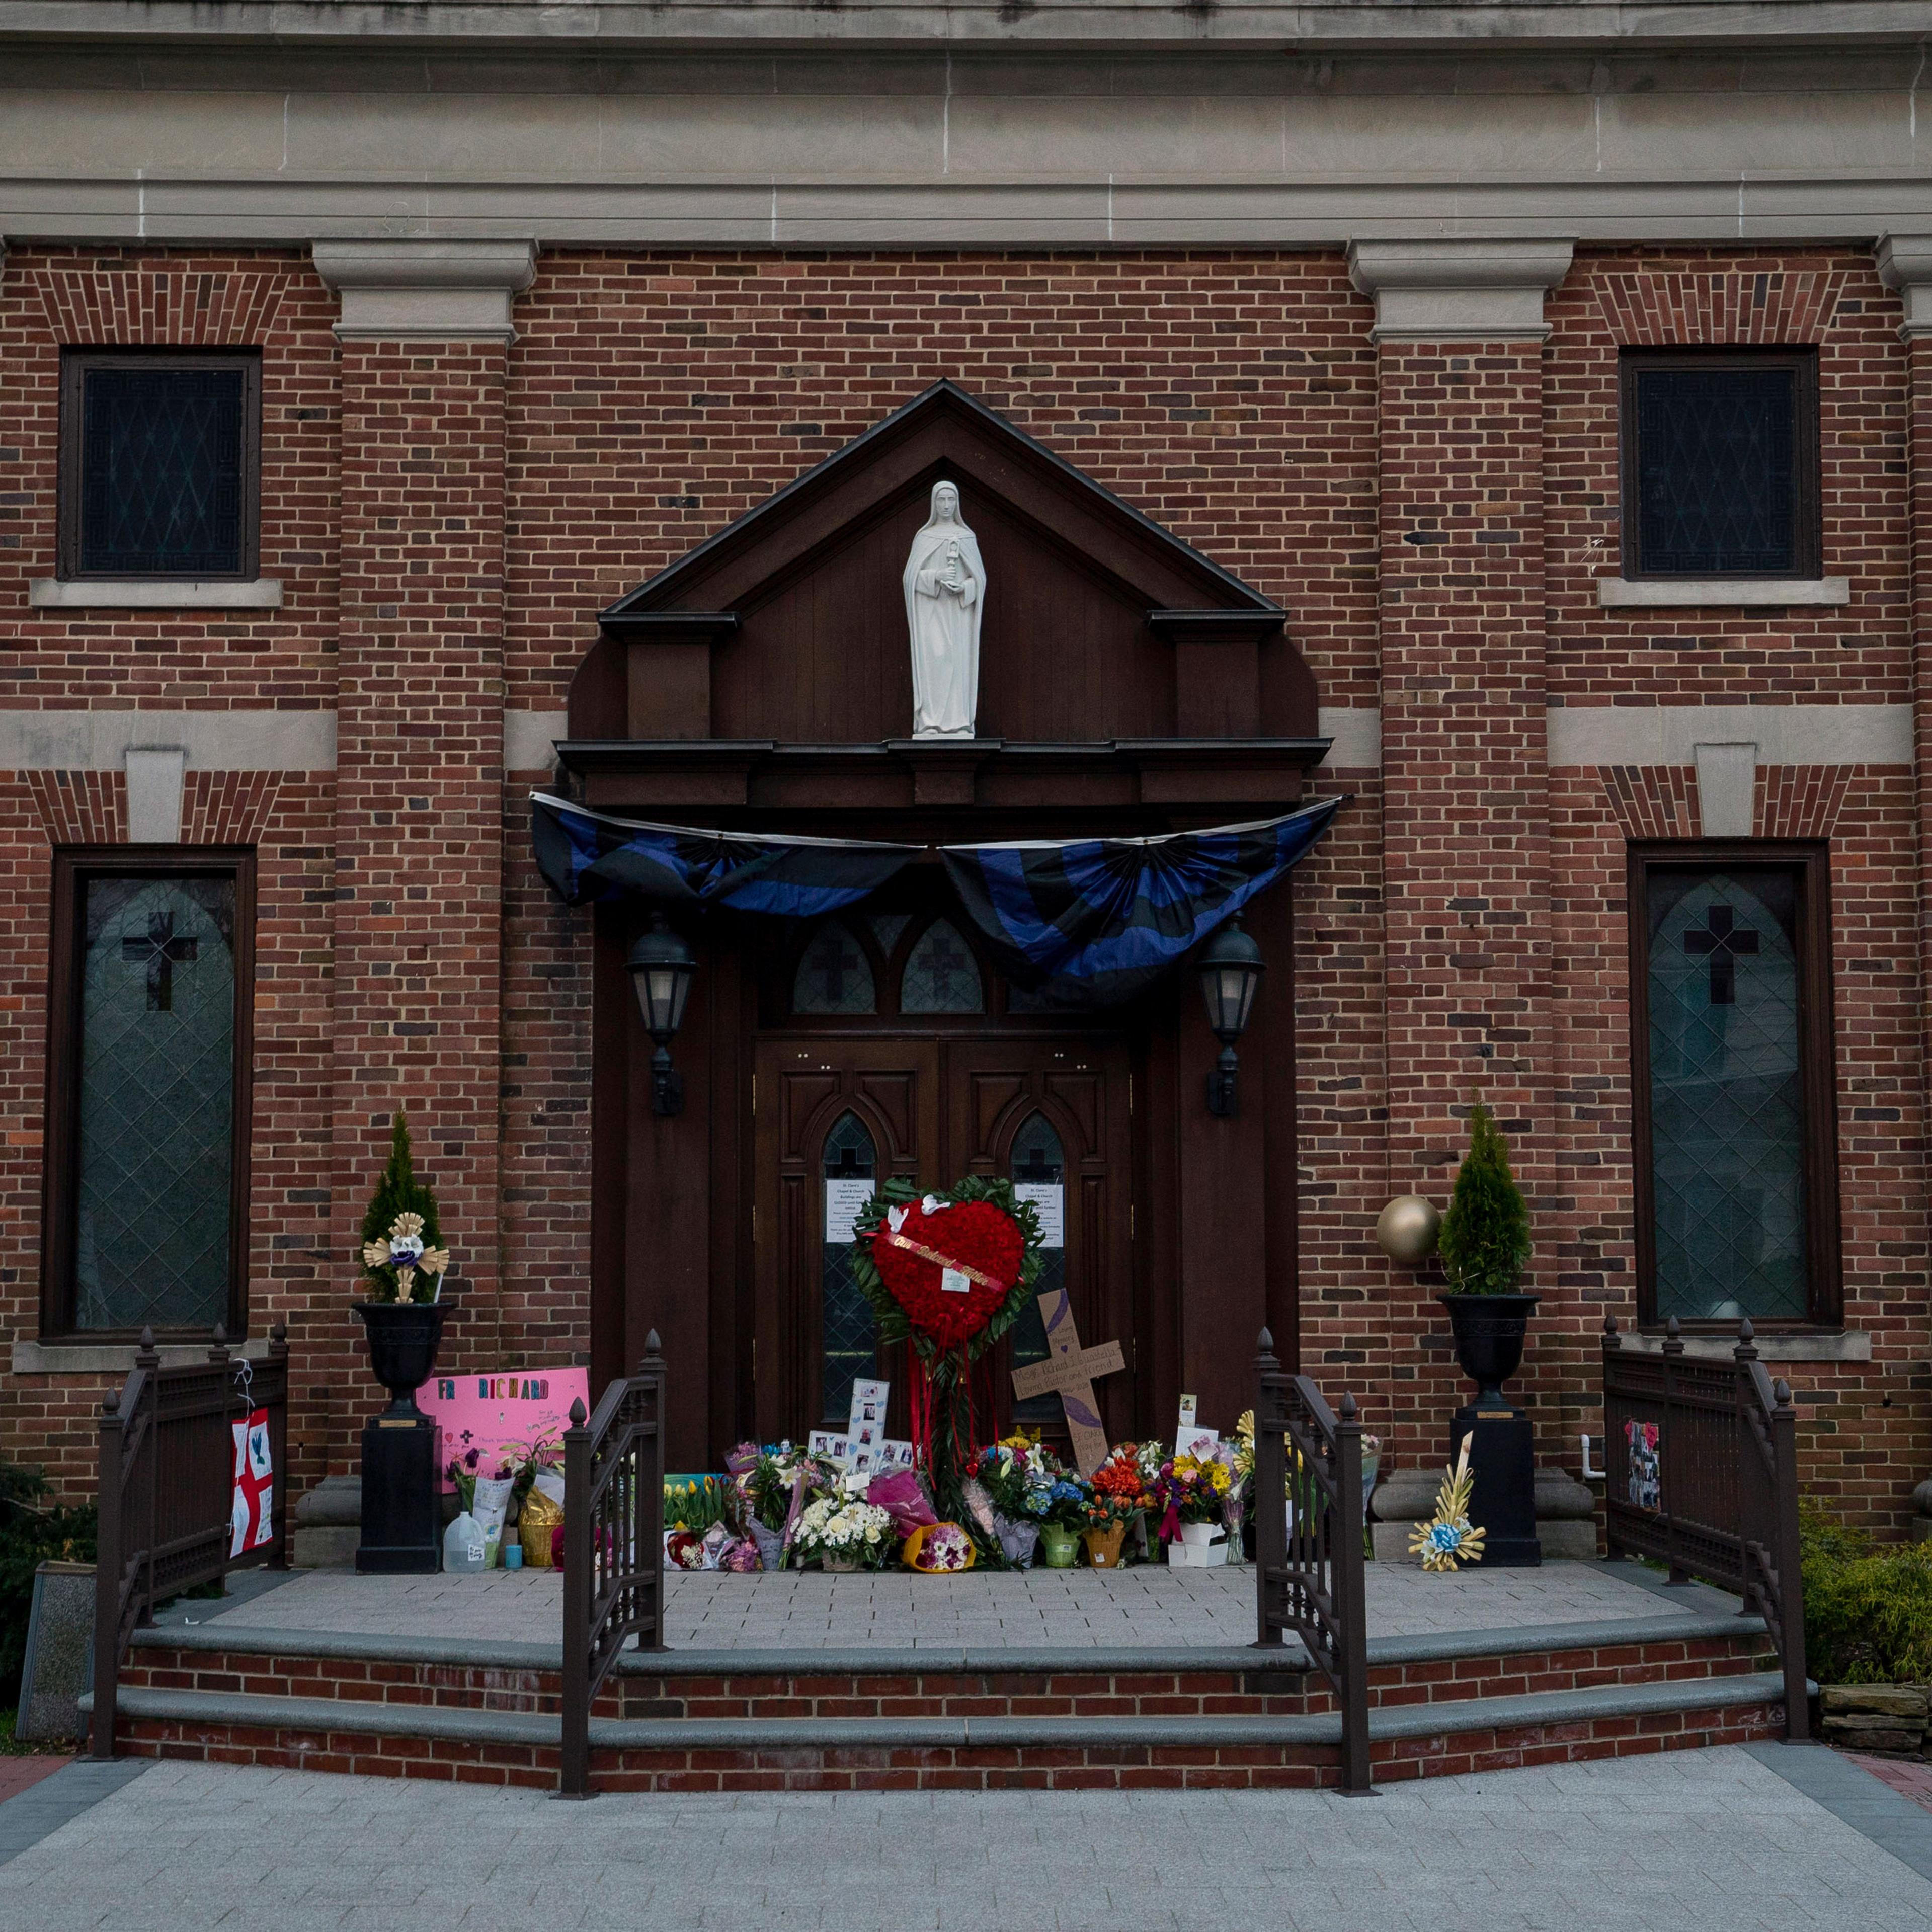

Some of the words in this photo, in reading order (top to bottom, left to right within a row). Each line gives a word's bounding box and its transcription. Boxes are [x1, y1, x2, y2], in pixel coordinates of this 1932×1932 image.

[894, 1236, 912, 1249] Our
[917, 1246, 957, 1268] Beloved
[961, 1265, 989, 1286] Father
[1052, 1335, 1074, 1345] Memory
[1041, 1358, 1068, 1375] Richard
[438, 1379, 455, 1400] FR
[478, 1378, 549, 1400] RICHARD
[1018, 1383, 1043, 1395] Loving
[1044, 1374, 1067, 1387] Pastor
[1069, 1370, 1082, 1380] and
